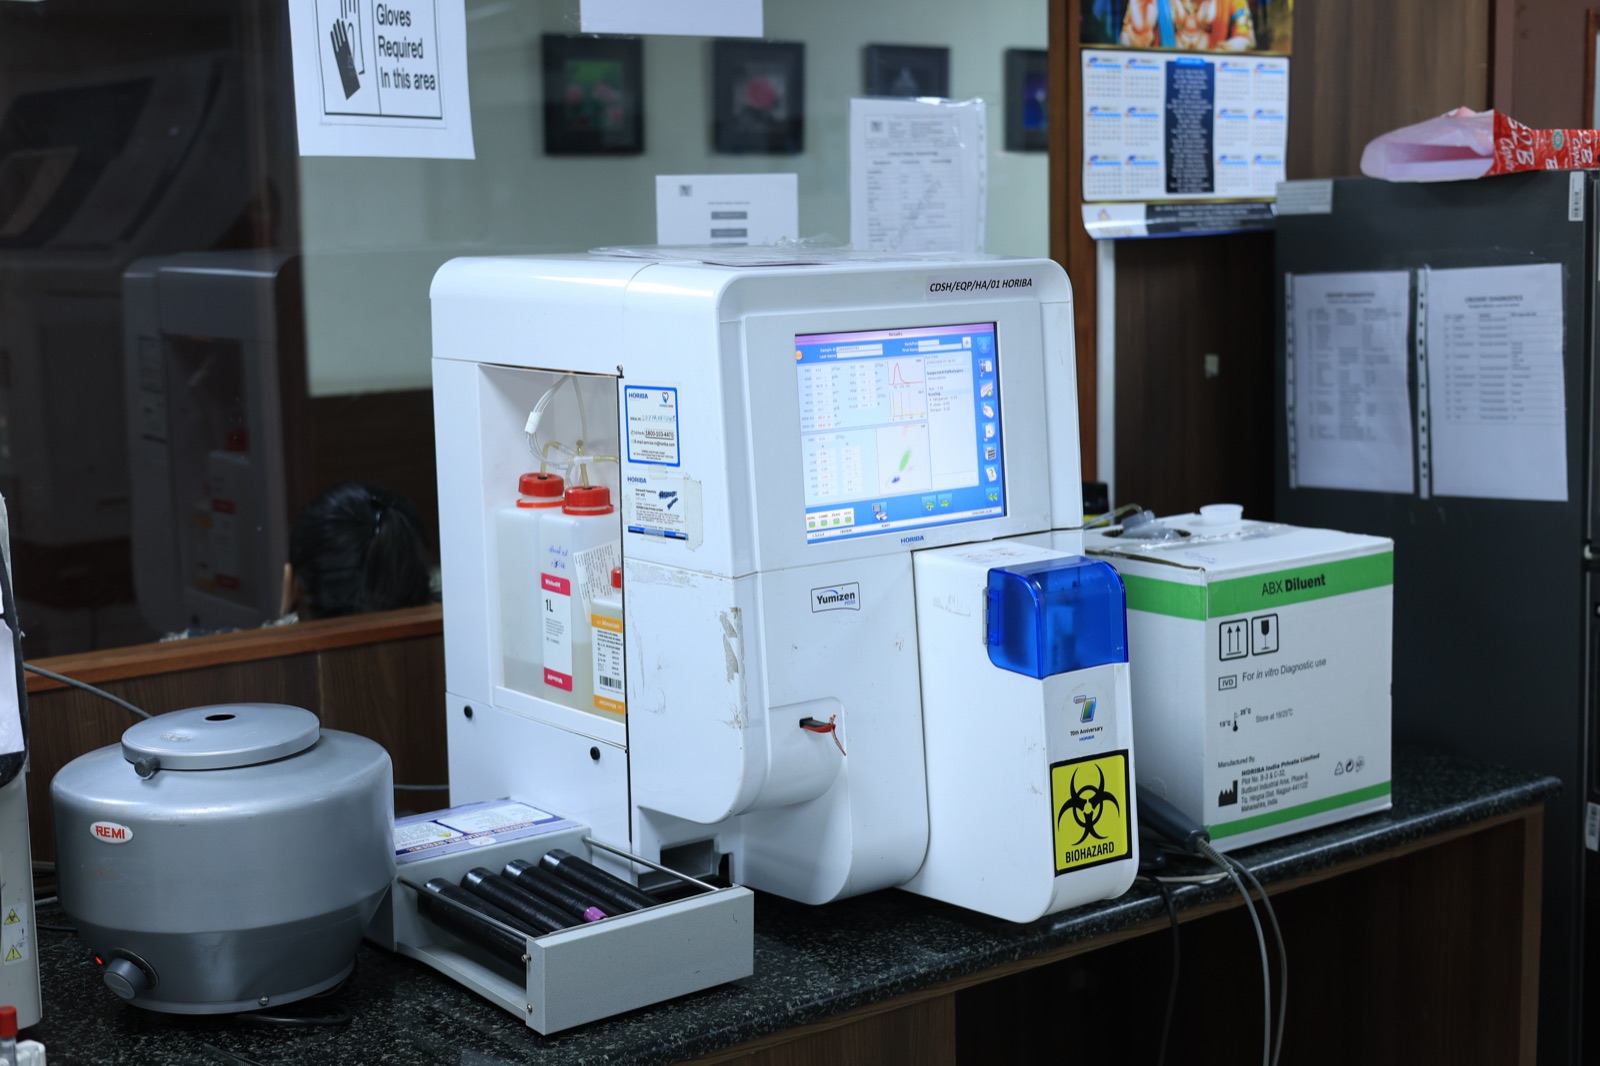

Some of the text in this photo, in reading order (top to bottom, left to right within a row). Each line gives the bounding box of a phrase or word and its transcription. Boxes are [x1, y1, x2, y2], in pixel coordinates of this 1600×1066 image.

[376, 3, 412, 28] Gloves
[378, 35, 424, 63] Required
[380, 67, 436, 91] In this area
[929, 278, 1033, 293] CDSH/EQP/HA/01 HORIBA
[900, 535, 924, 544] HORIBA
[1262, 573, 1326, 597] ABX Diluent
[816, 592, 856, 605] Yumizen
[1242, 659, 1327, 682] For in vitro Diagnostic use
[1222, 679, 1234, 687] IVD
[1080, 726, 1103, 735] Anniversary
[1217, 757, 1248, 768] Manufactured
[1241, 766, 1264, 777] HORIBA
[1266, 763, 1280, 771] India
[95, 825, 125, 839] REMI
[1065, 841, 1115, 864] BIOHAZARD
